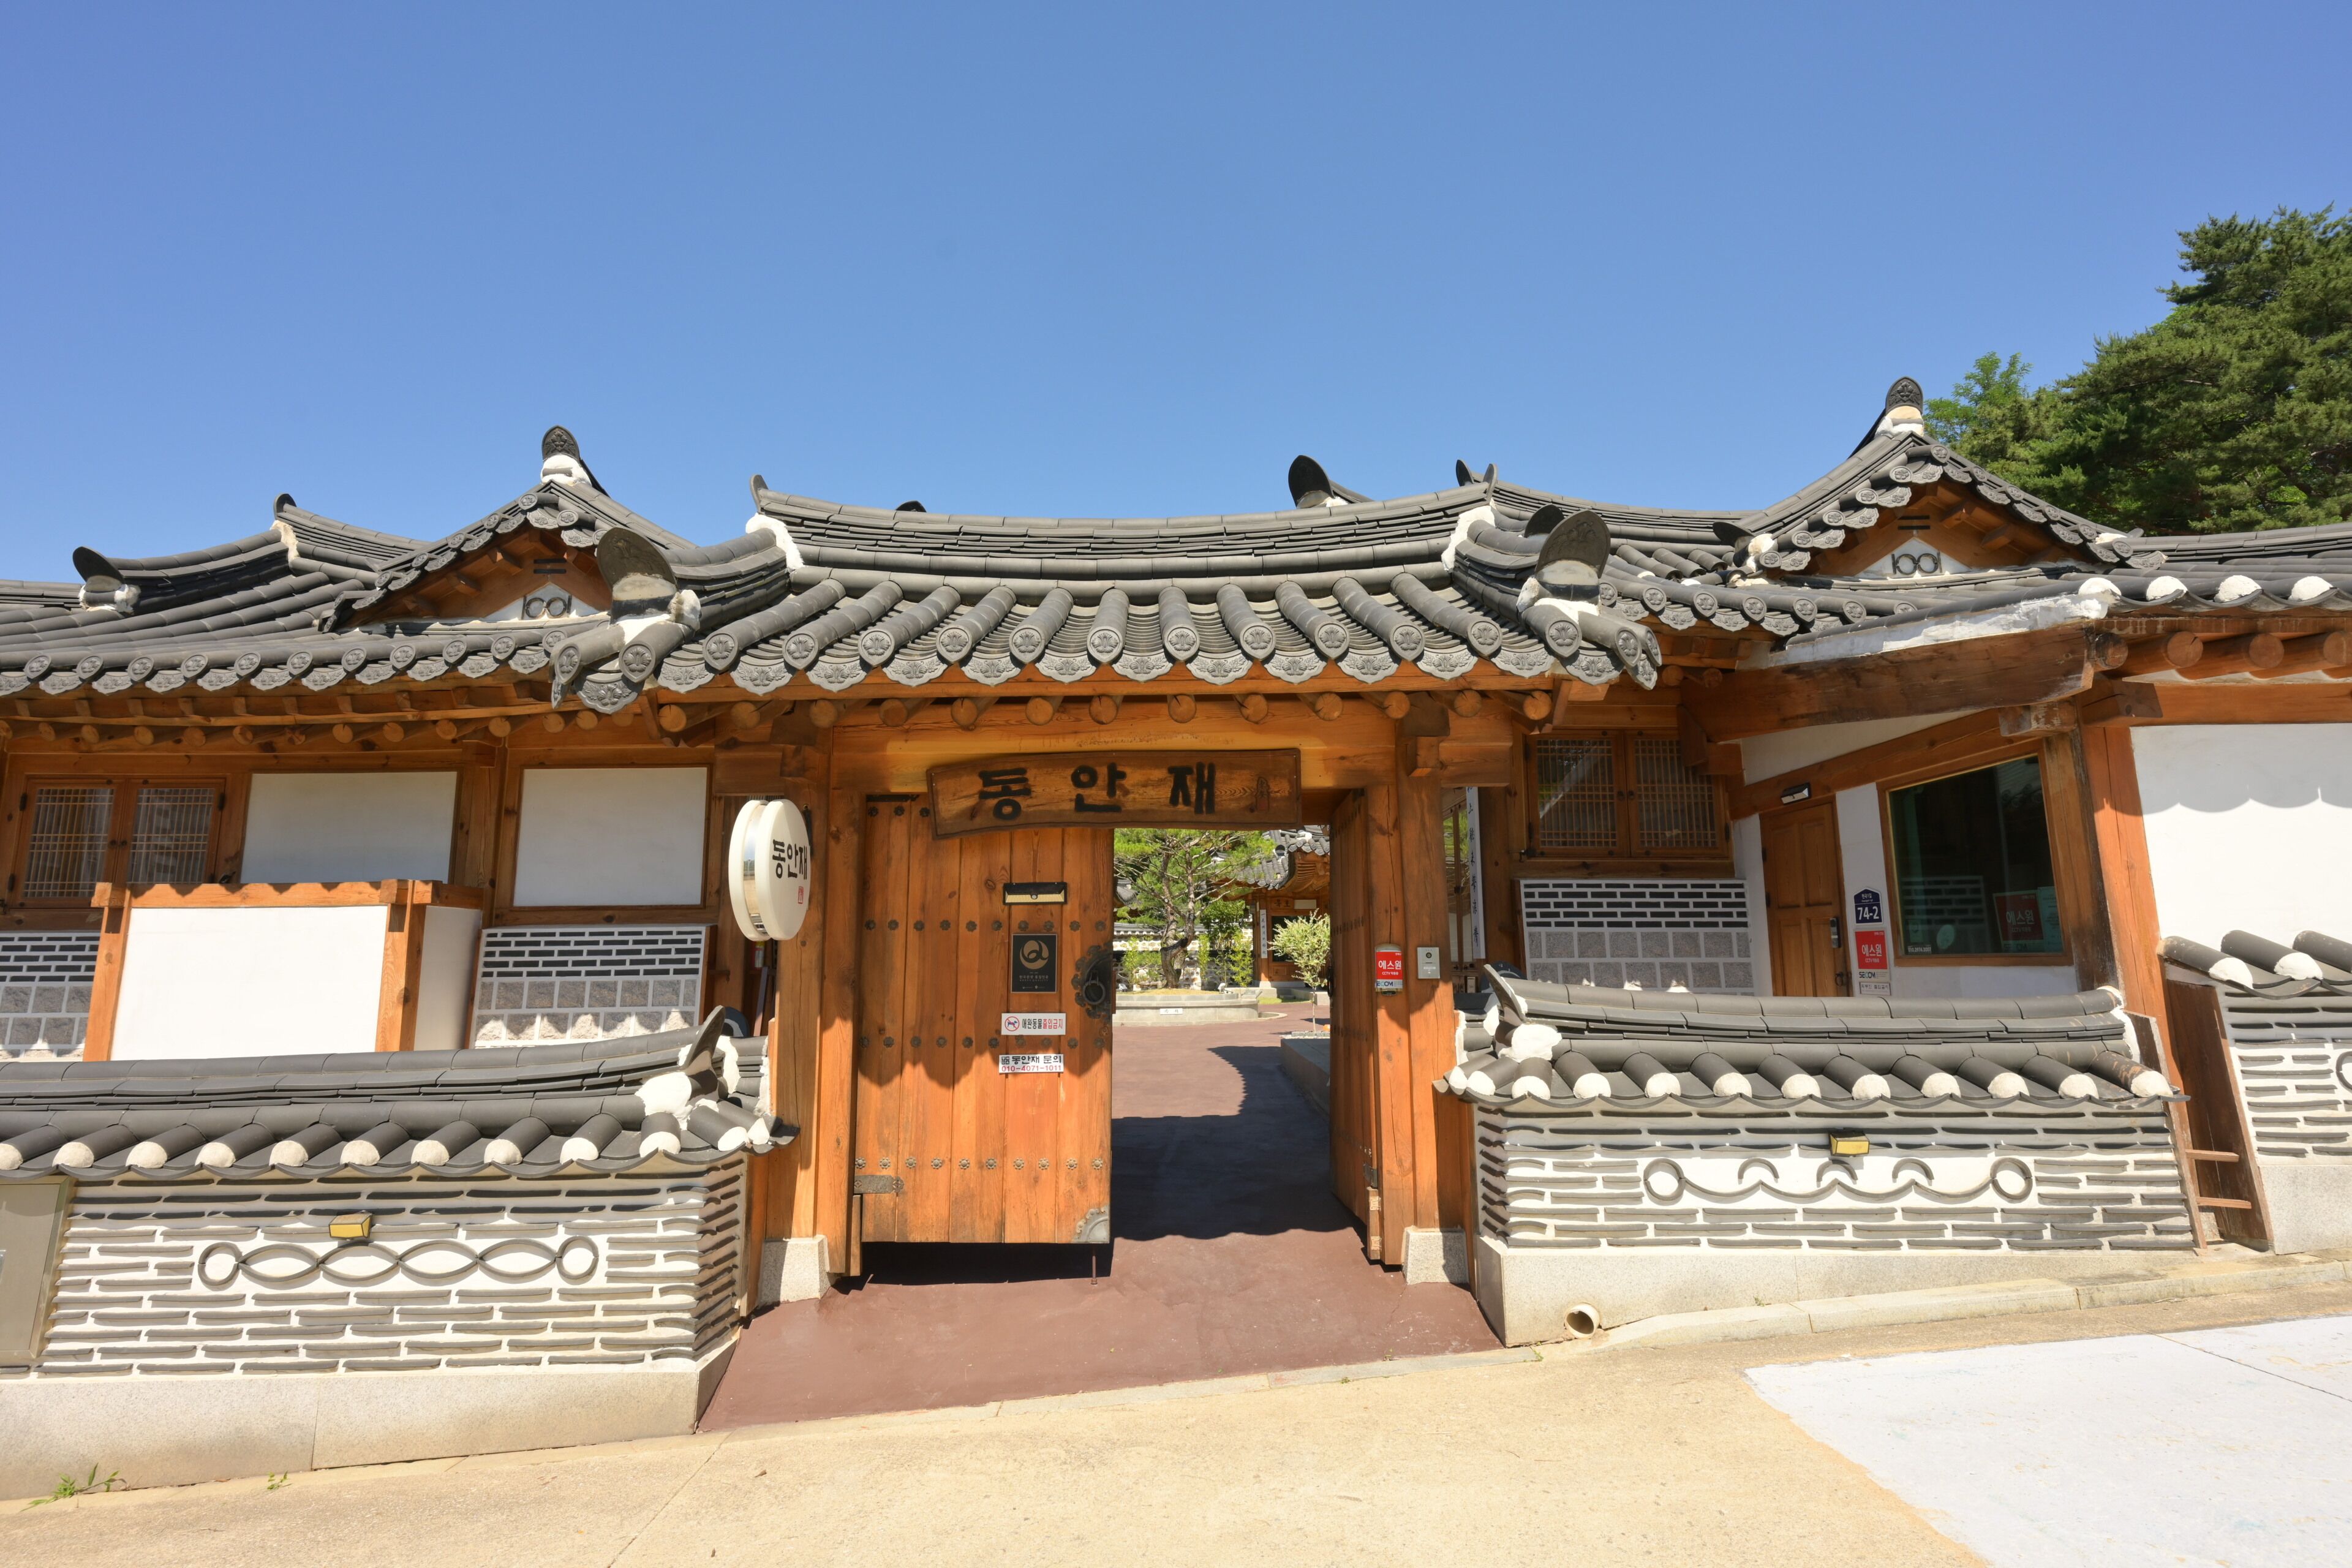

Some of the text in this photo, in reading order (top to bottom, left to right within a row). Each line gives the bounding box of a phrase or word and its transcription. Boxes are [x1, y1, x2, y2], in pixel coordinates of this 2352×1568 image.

[978, 761, 1216, 821] 동안재
[772, 839, 808, 880] 동안재
[1857, 906, 1880, 921] 74-2
[2005, 909, 2035, 925] 에스원
[1862, 943, 1882, 957] 에스원
[1378, 960, 1401, 970] 에스원
[1012, 1055, 1040, 1065] 동안재
[1043, 1055, 1061, 1064] 문의
